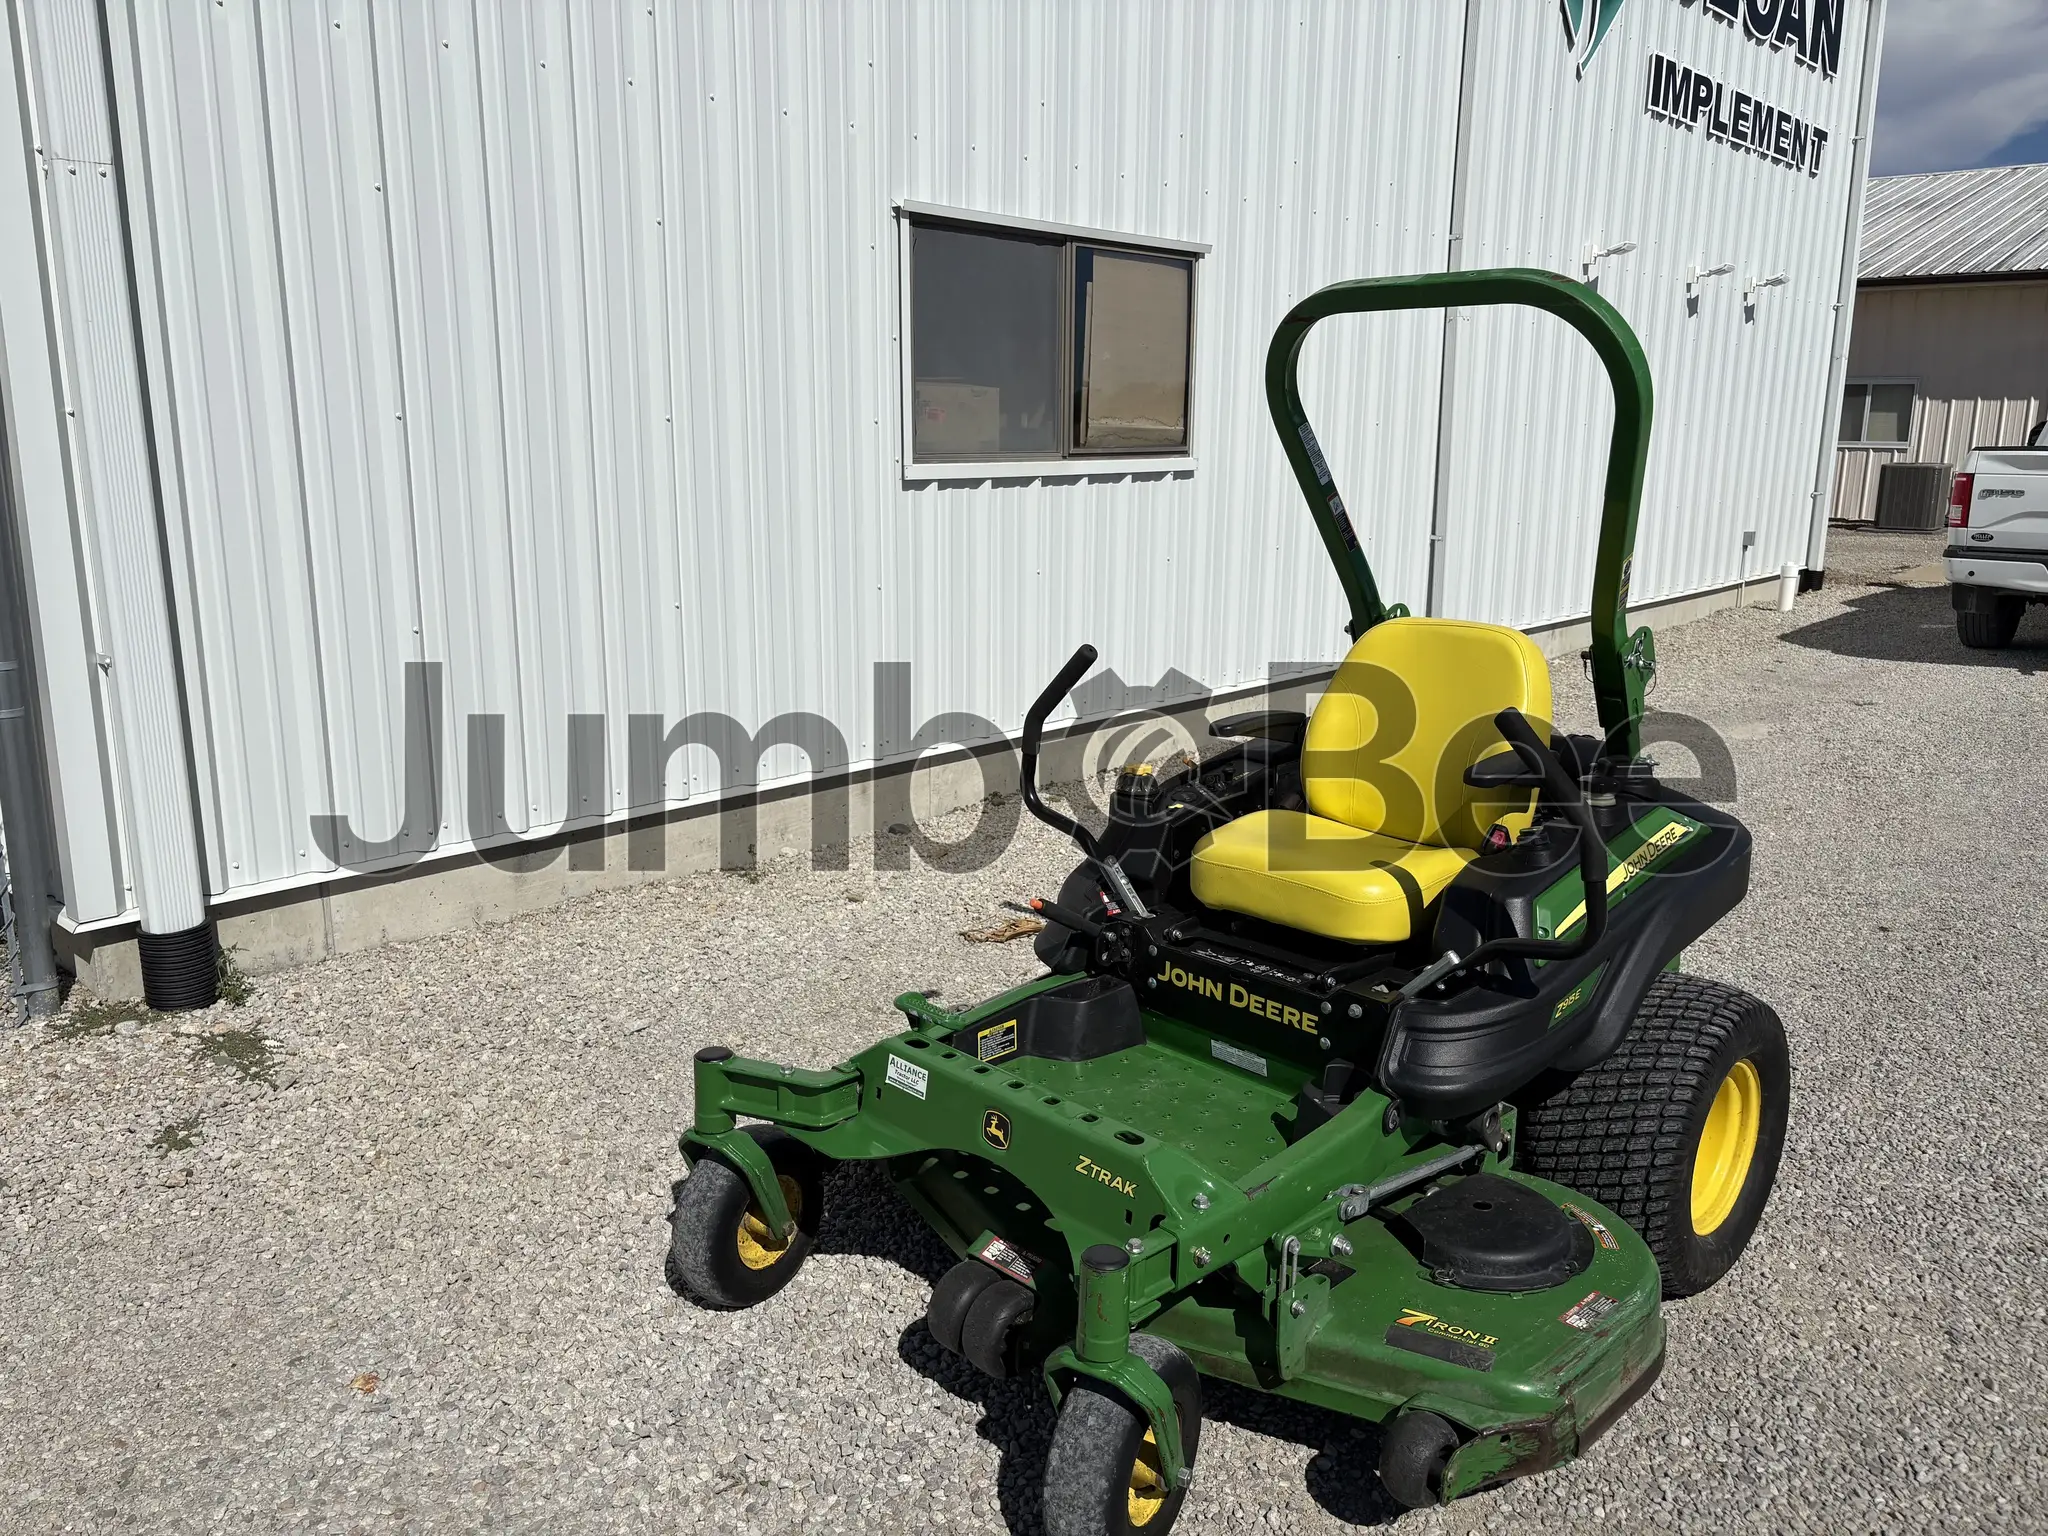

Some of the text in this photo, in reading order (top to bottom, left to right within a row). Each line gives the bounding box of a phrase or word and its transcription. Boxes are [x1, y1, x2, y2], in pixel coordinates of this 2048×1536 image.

[1648, 52, 1829, 174] IMPLEMENT
[1622, 827, 1678, 880] JOHN DEERE
[1157, 961, 1319, 1035] JOHN DEERE
[890, 1057, 927, 1082] ALLIANCE
[1075, 1154, 1138, 1198] ZTRAK
[1427, 1327, 1477, 1345] Commercial
